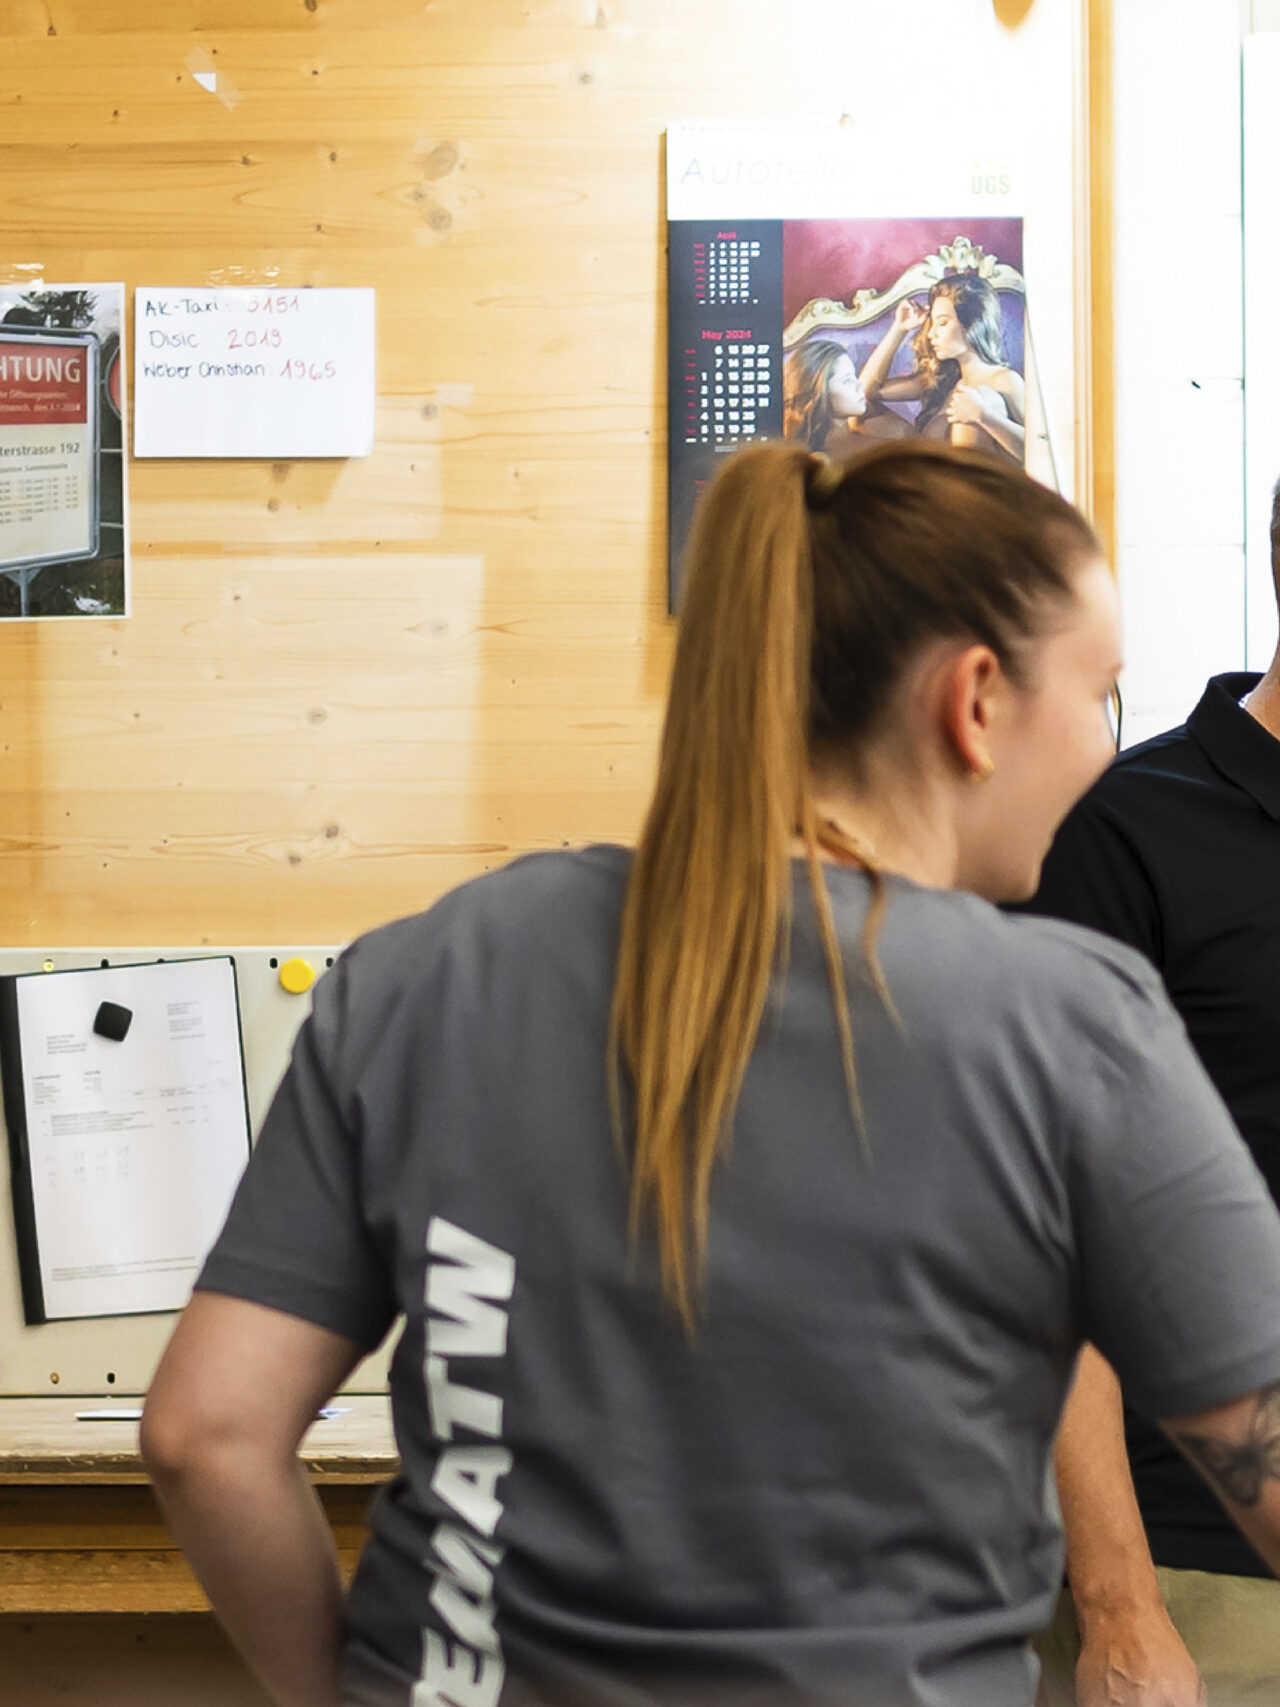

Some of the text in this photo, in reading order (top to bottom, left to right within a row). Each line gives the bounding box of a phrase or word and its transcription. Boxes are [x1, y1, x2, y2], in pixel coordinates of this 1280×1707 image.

[971, 174, 1011, 196] UGS
[227, 329, 283, 350] 2019
[701, 330, 722, 343] May
[278, 358, 337, 380] 1965
[60, 442, 80, 454] 192
